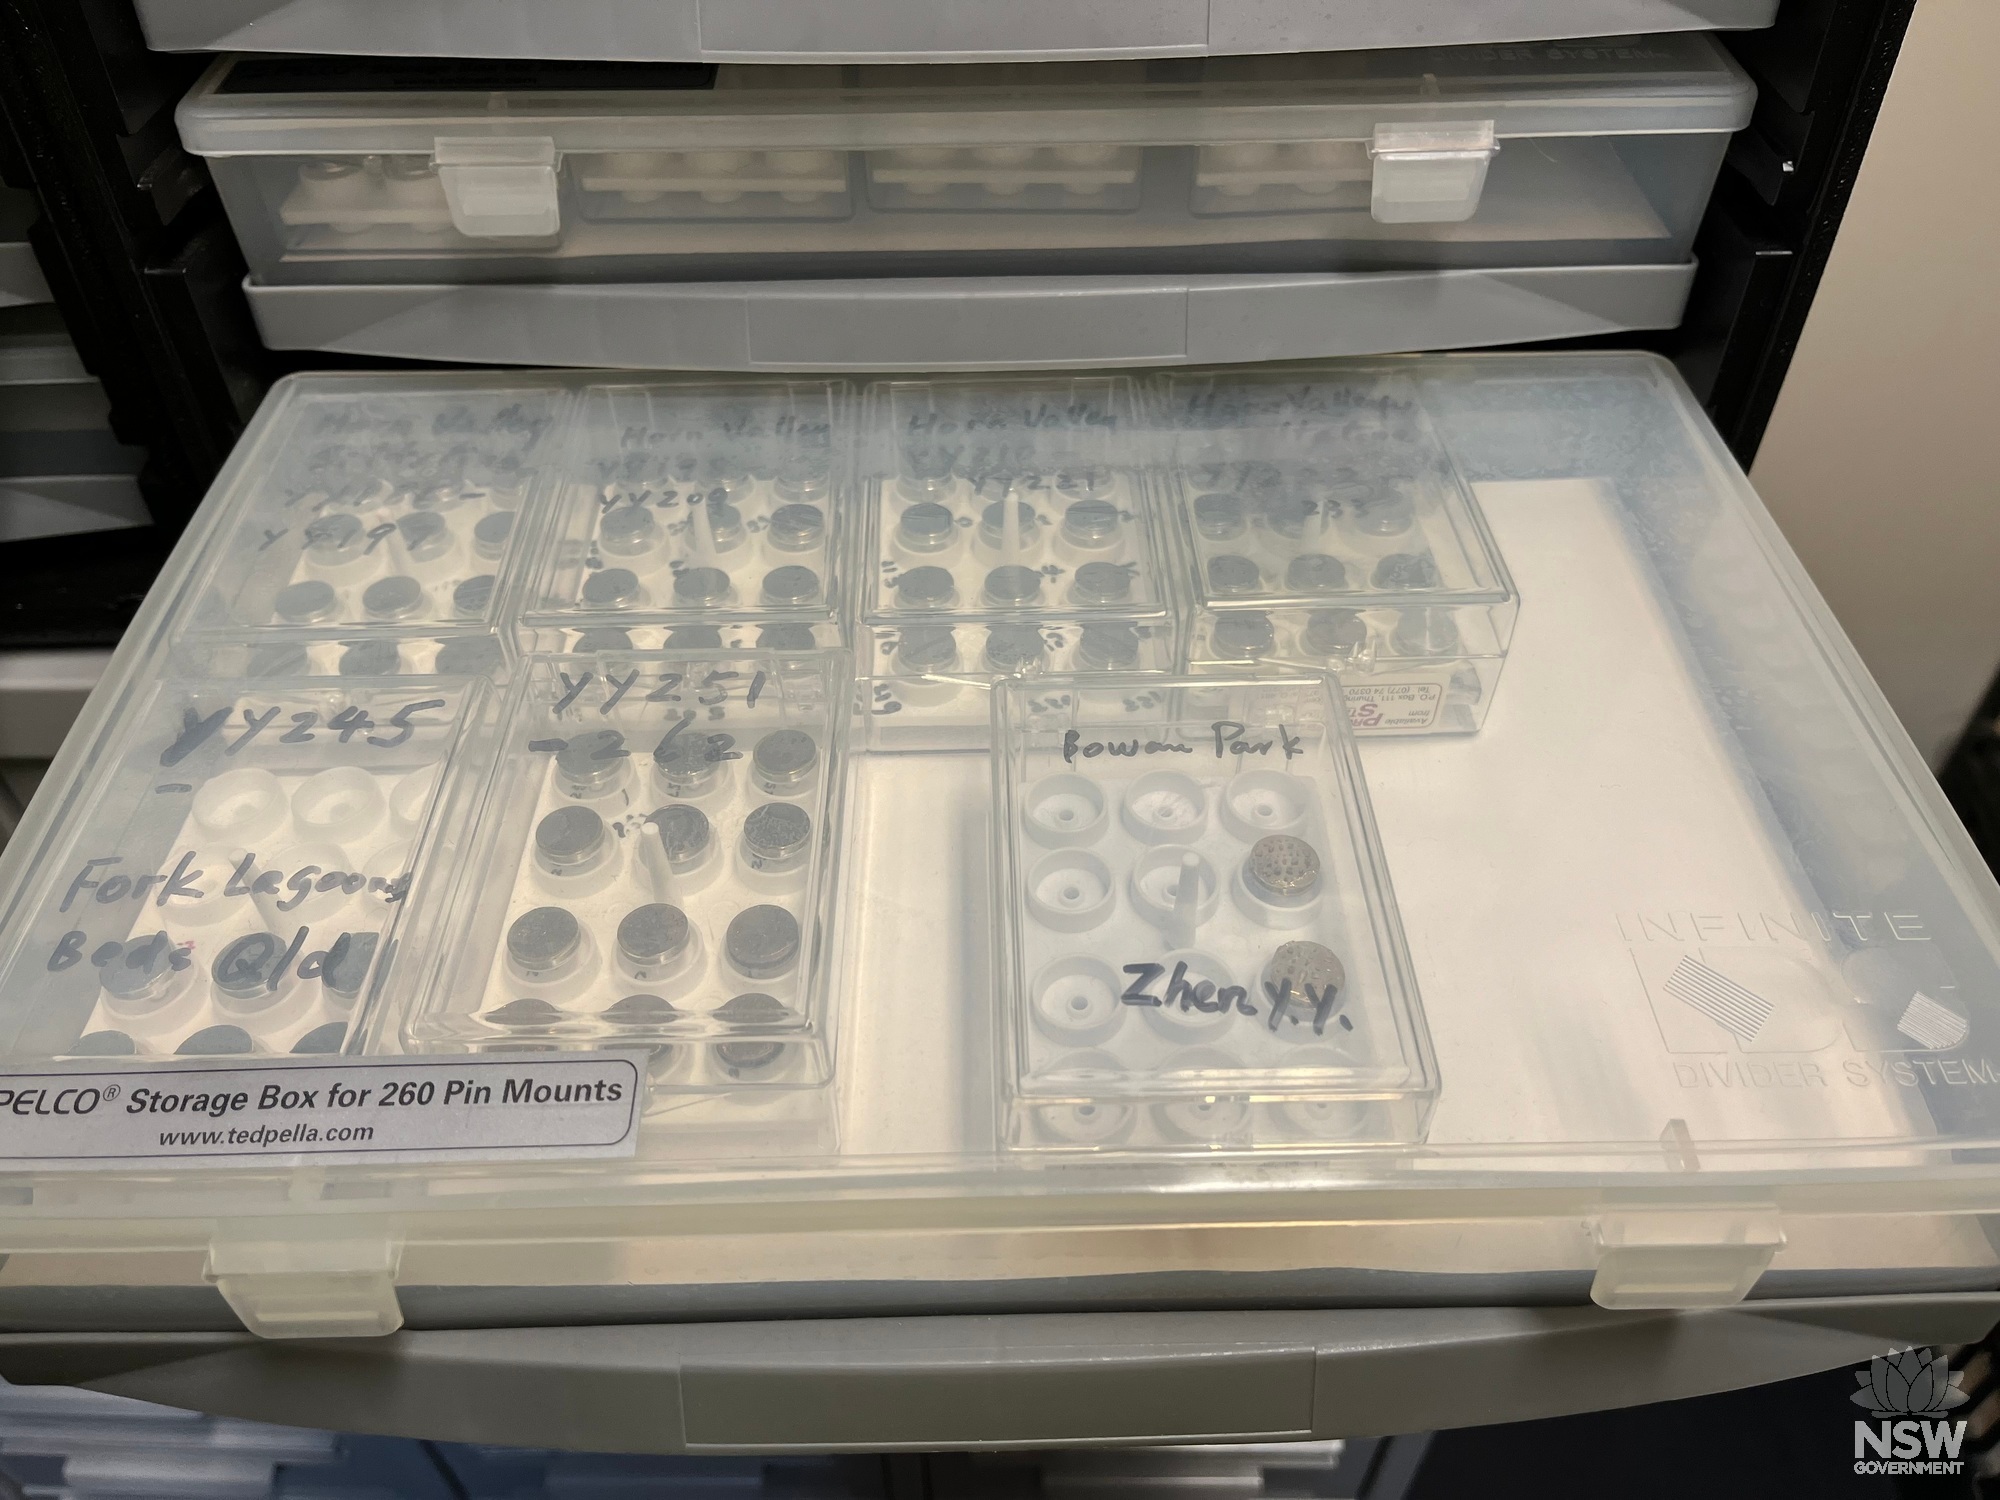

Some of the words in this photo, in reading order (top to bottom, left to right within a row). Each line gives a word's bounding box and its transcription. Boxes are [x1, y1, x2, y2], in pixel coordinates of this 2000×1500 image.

[553, 669, 766, 715] YY251
[160, 699, 446, 767] YY245
[1384, 717, 1429, 726] Available
[1408, 709, 1430, 717] from
[1211, 720, 1304, 759] Park
[60, 851, 204, 913] Fork
[1615, 911, 1932, 942] INFINITE
[47, 930, 192, 972] Beds
[1121, 961, 1258, 1016] Zhen
[1673, 1060, 1829, 1089] DIVIDER
[126, 1087, 249, 1118] Storage
[257, 1084, 319, 1111] Box
[326, 1081, 373, 1108] for
[378, 1080, 435, 1107] 260
[443, 1079, 492, 1105] Pin
[501, 1077, 623, 1104] Mounts
[159, 1122, 374, 1148] www.tedpella.com
